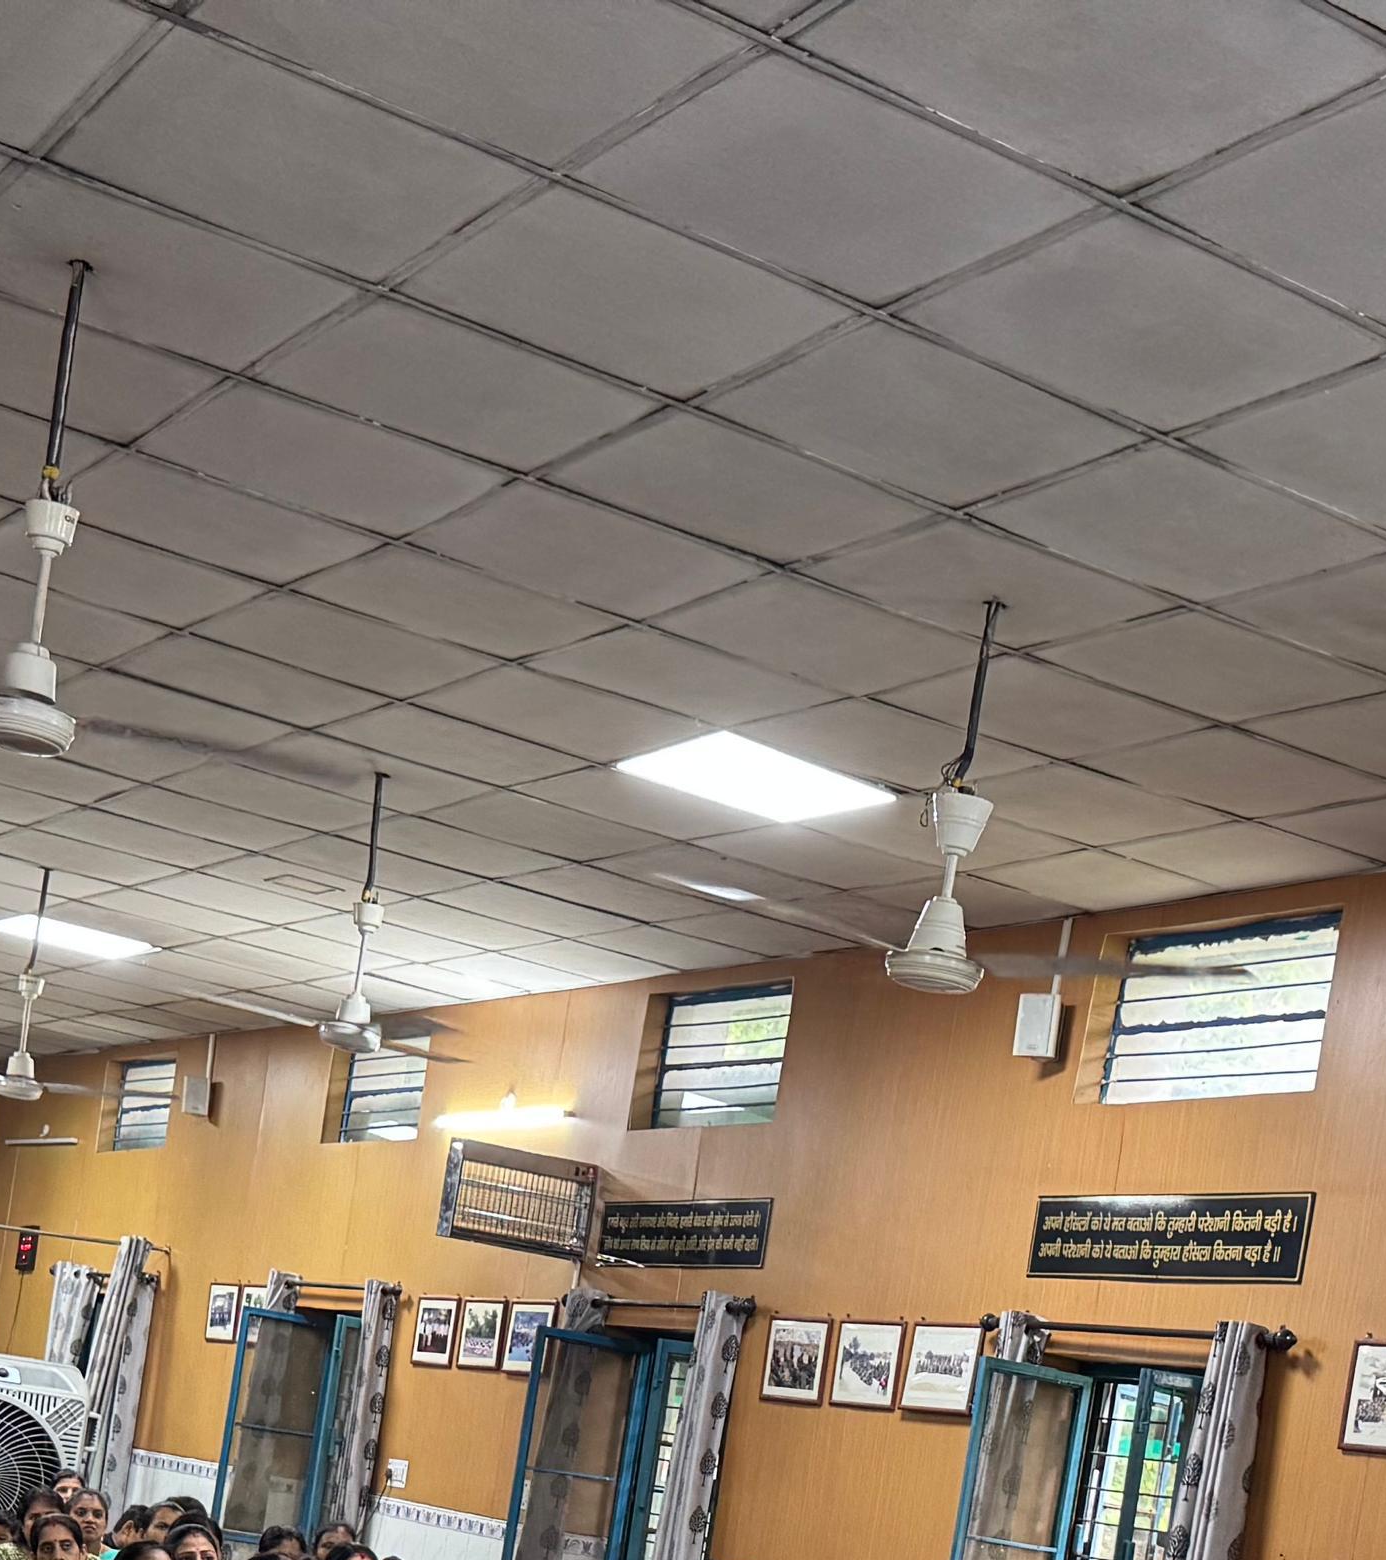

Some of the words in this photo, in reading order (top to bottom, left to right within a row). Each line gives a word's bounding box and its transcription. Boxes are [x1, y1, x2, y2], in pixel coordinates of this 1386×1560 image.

[1042, 1211, 1063, 1231] अपने
[1091, 1211, 1103, 1231] को
[1103, 1211, 1111, 1231] ये
[1111, 1216, 1126, 1231] मत
[1154, 1210, 1167, 1231] कि
[1166, 1210, 1197, 1239] तुम्हारी
[1198, 1210, 1230, 1232] परेशानी
[1038, 1237, 1062, 1258] अपनी
[1062, 1238, 1091, 1258] परेशानी
[1091, 1239, 1104, 1259] को
[1104, 1239, 1112, 1259] ये
[1139, 1239, 1153, 1260] कि
[1153, 1245, 1182, 1268] तुम्हारा
[1212, 1239, 1244, 1262] कितना
